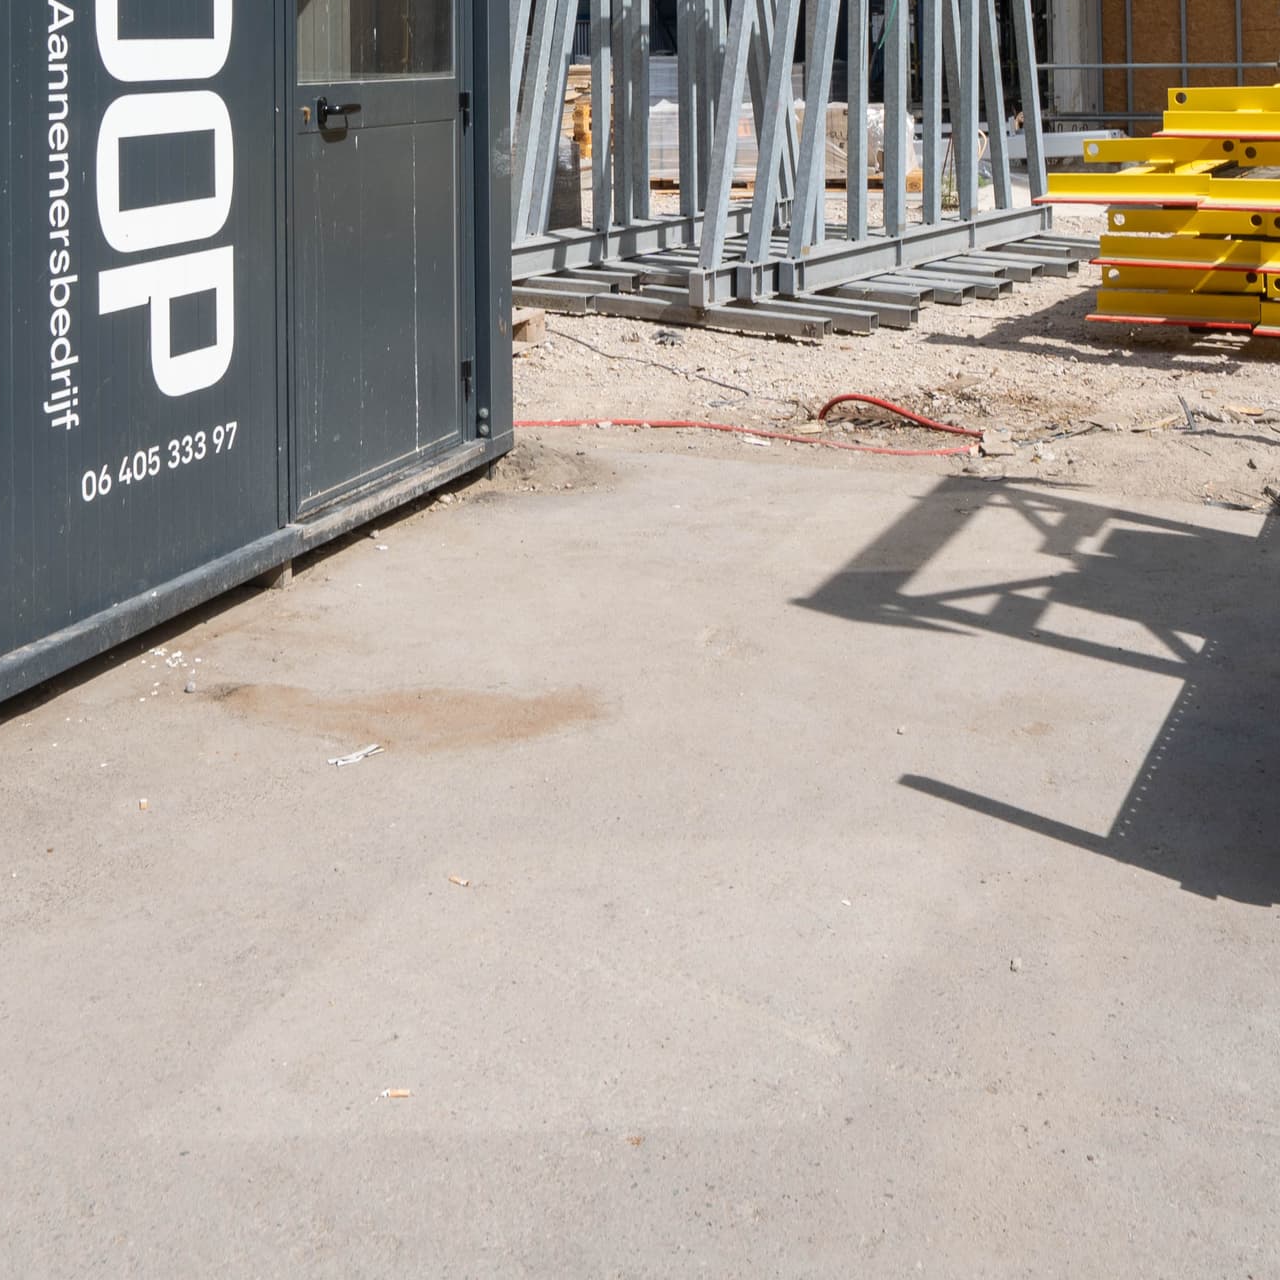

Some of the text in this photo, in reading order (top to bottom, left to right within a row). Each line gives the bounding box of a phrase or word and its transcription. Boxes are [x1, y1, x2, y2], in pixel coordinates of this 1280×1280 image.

[80, 420, 239, 502] 06 405 333 97
